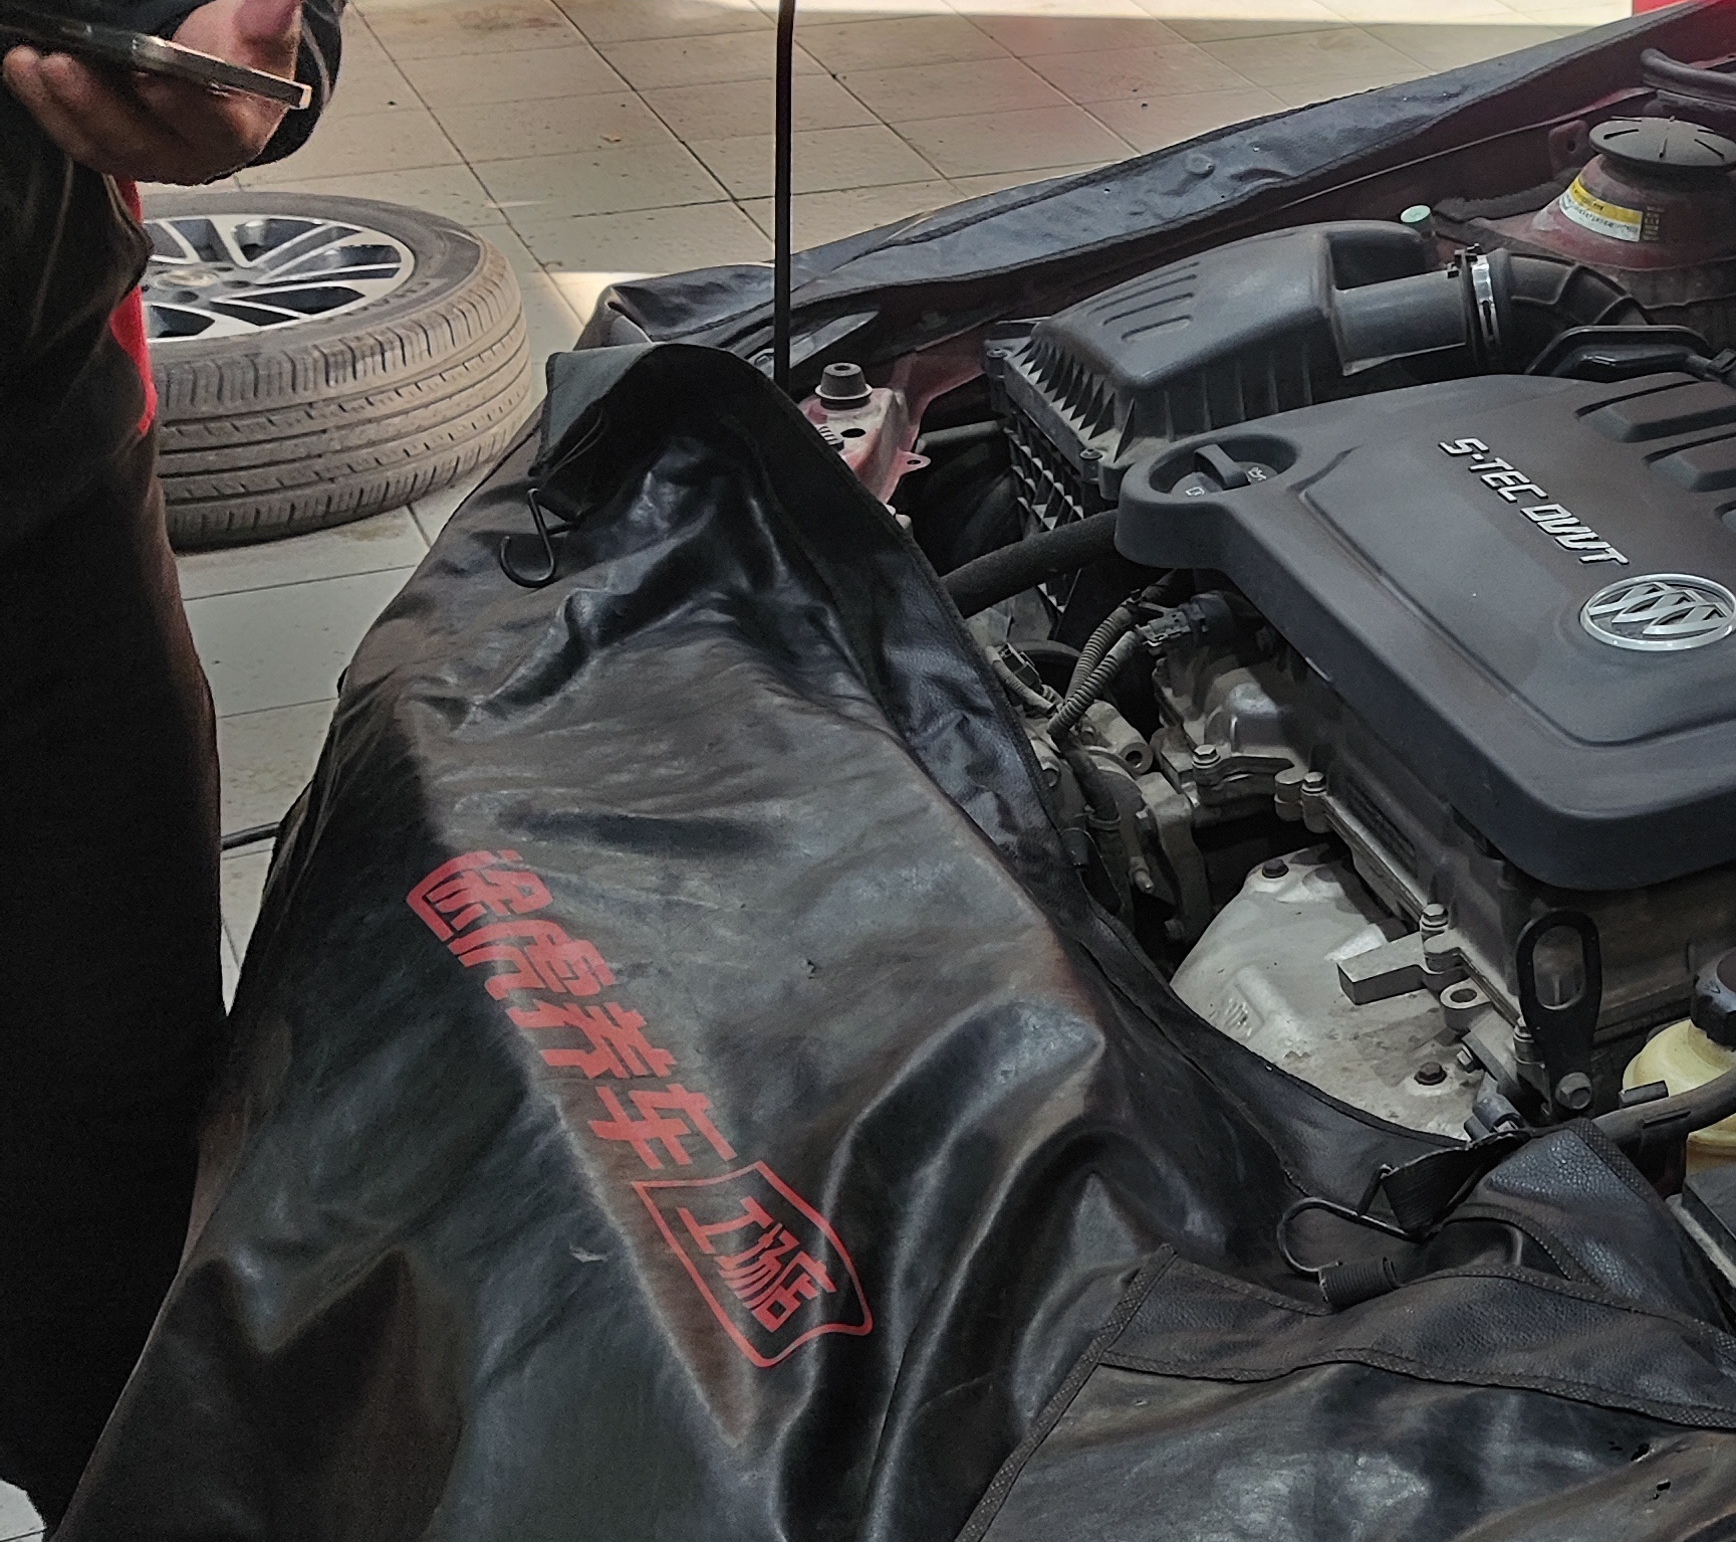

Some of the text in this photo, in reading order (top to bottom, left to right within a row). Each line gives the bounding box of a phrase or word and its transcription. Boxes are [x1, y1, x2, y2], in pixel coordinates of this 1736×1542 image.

[1519, 502, 1631, 565] DVVT
[406, 849, 837, 1333] 途虎养车 工场店
